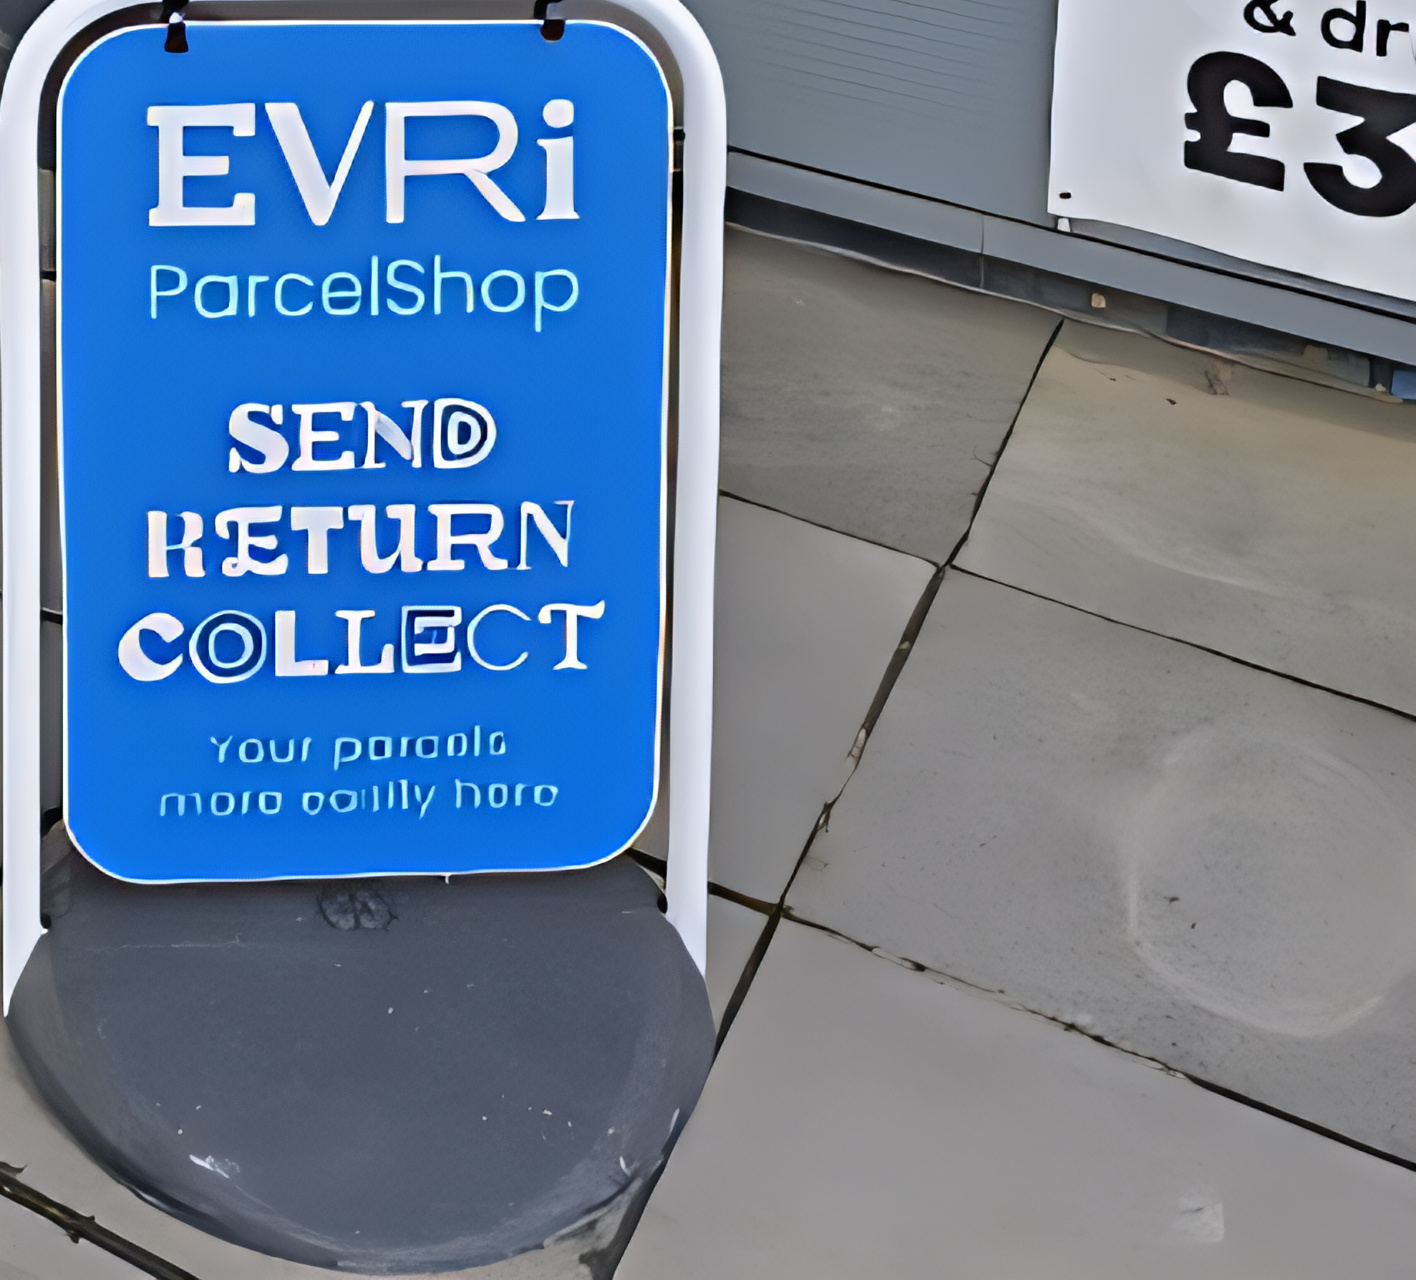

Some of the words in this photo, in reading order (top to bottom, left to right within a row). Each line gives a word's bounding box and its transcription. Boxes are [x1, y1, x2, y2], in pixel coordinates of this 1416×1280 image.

[1320, 0, 1410, 57] dr
[1184, 51, 1416, 217] £3
[150, 254, 579, 332] ParcelShop
[228, 398, 496, 474] SEND
[147, 500, 575, 577] RETURN
[117, 600, 605, 684] COLLECT
[210, 735, 312, 763] Your
